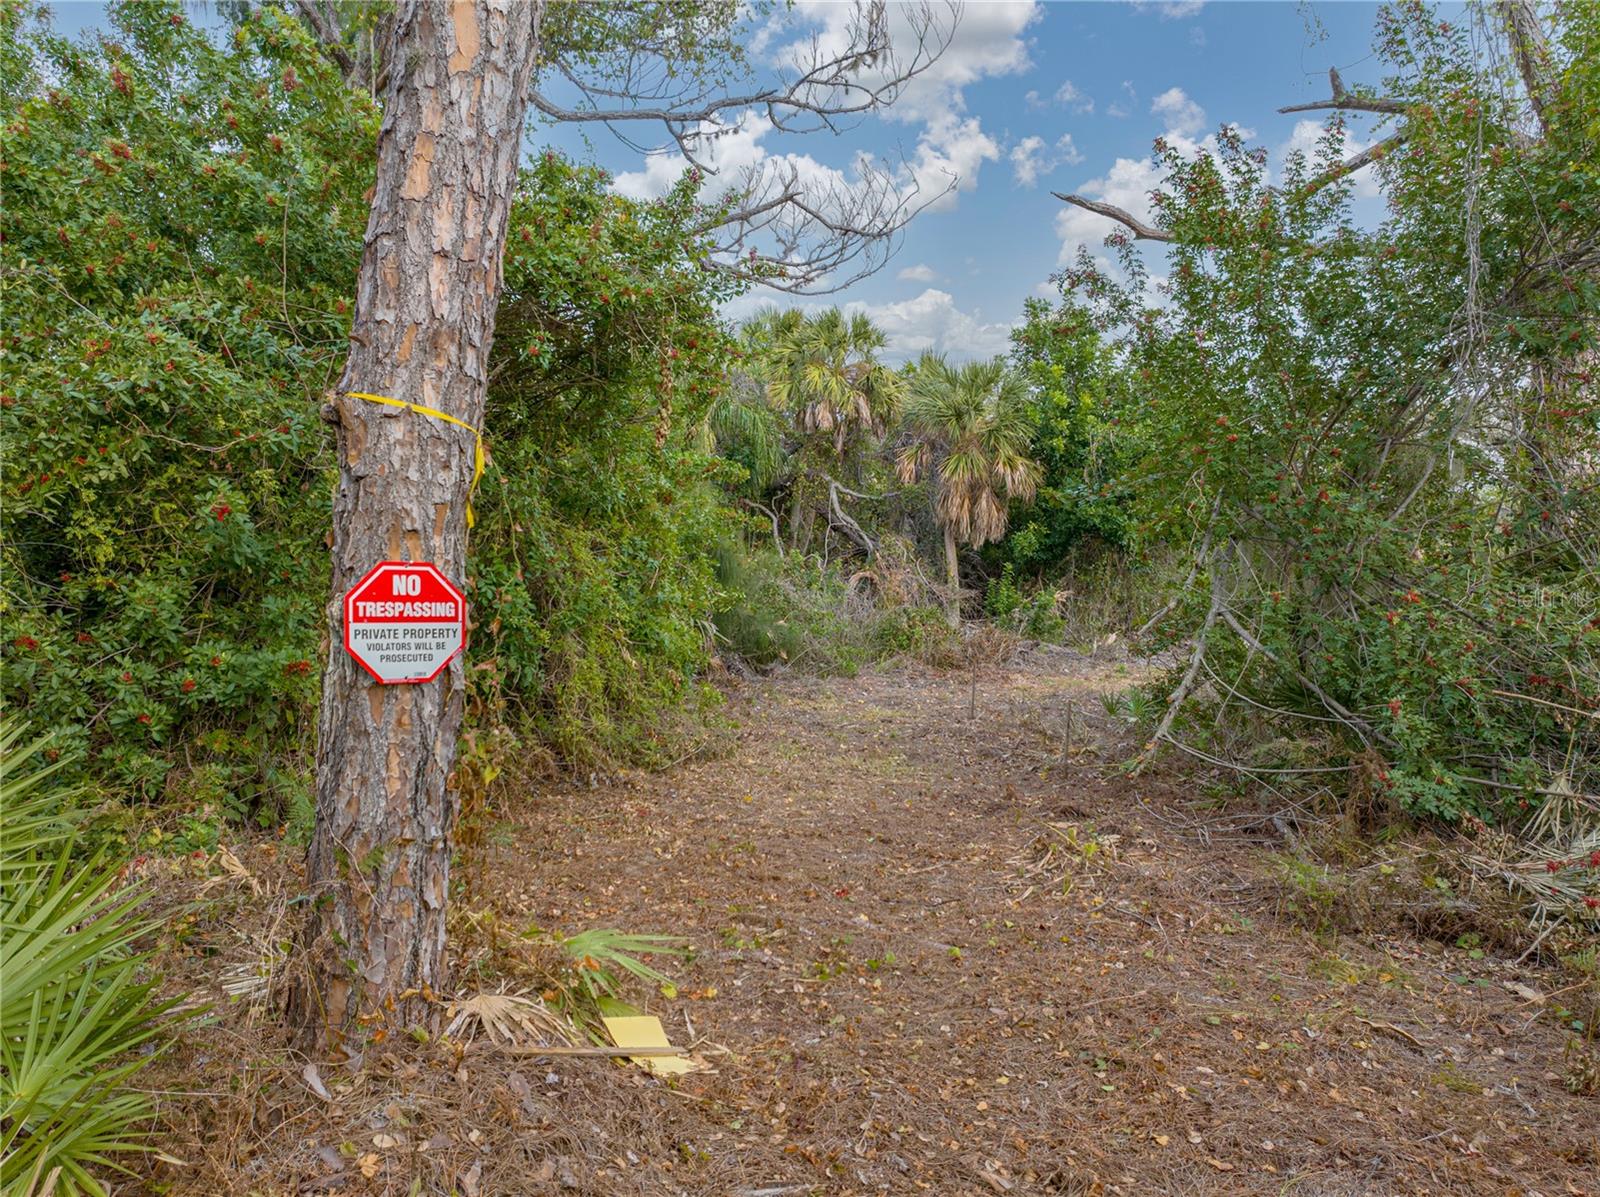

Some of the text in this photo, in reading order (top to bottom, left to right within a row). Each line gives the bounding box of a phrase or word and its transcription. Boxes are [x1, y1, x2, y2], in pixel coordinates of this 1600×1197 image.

[392, 574, 421, 596] NO
[356, 601, 455, 617] TRESPASSING
[354, 628, 458, 639] PRIVATE PROPERTY
[366, 642, 446, 651] VIOLATORS WILL BE
[380, 653, 433, 662] PROSECUTED
